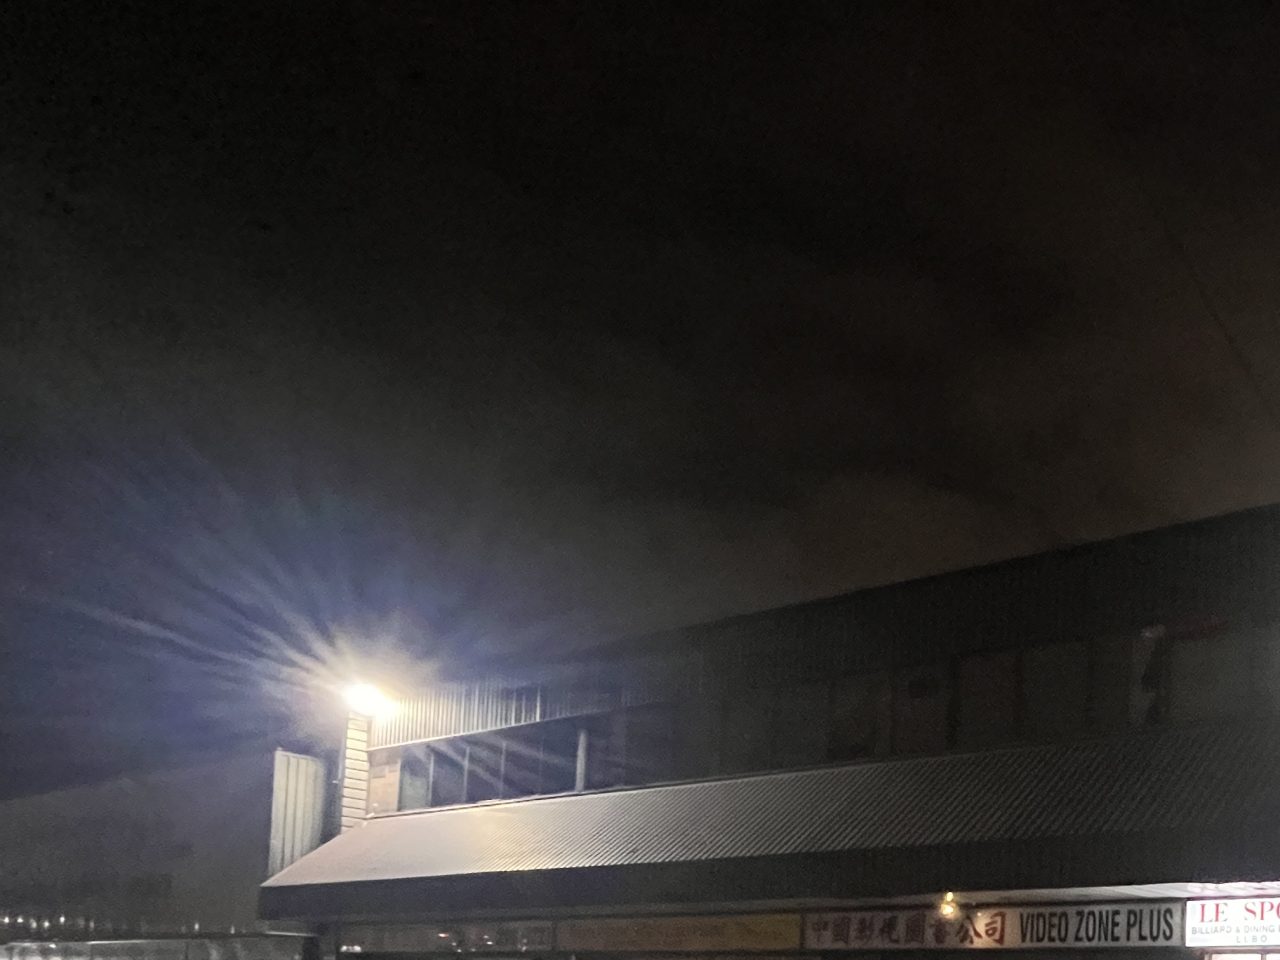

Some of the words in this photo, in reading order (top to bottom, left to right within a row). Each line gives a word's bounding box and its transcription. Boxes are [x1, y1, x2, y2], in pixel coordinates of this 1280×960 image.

[1199, 902, 1228, 923] LE
[1019, 912, 1068, 942] VIDEO
[1074, 909, 1121, 942] ZONE
[1126, 907, 1174, 942] PLUS
[1191, 925, 1233, 935] BILLIARD
[1244, 925, 1275, 934] DINING
